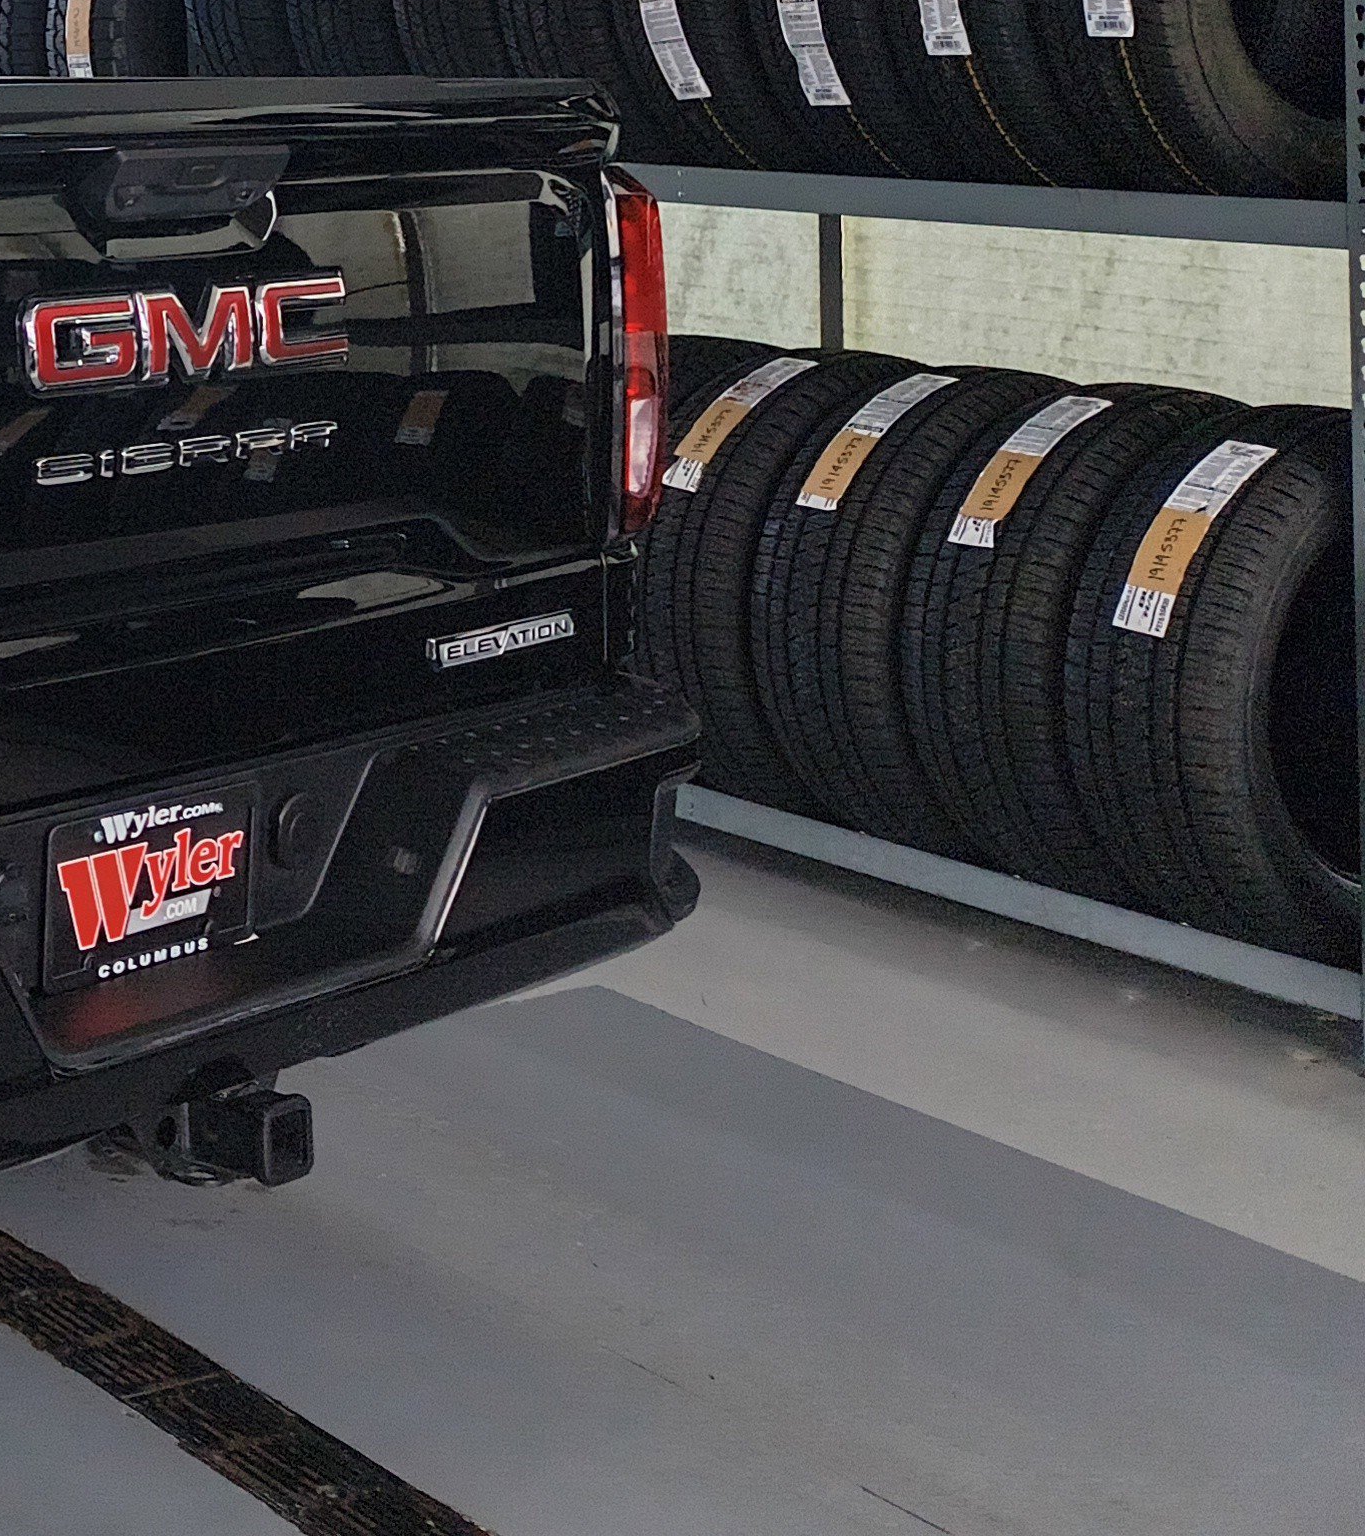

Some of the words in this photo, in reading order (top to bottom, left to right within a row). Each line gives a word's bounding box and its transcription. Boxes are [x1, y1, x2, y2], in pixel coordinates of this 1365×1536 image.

[24, 271, 348, 394] GMC
[35, 420, 338, 486] SIERRA
[447, 619, 568, 660] ELEVATION
[57, 827, 244, 951] Wyler
[98, 937, 209, 978] COLUMBUS
